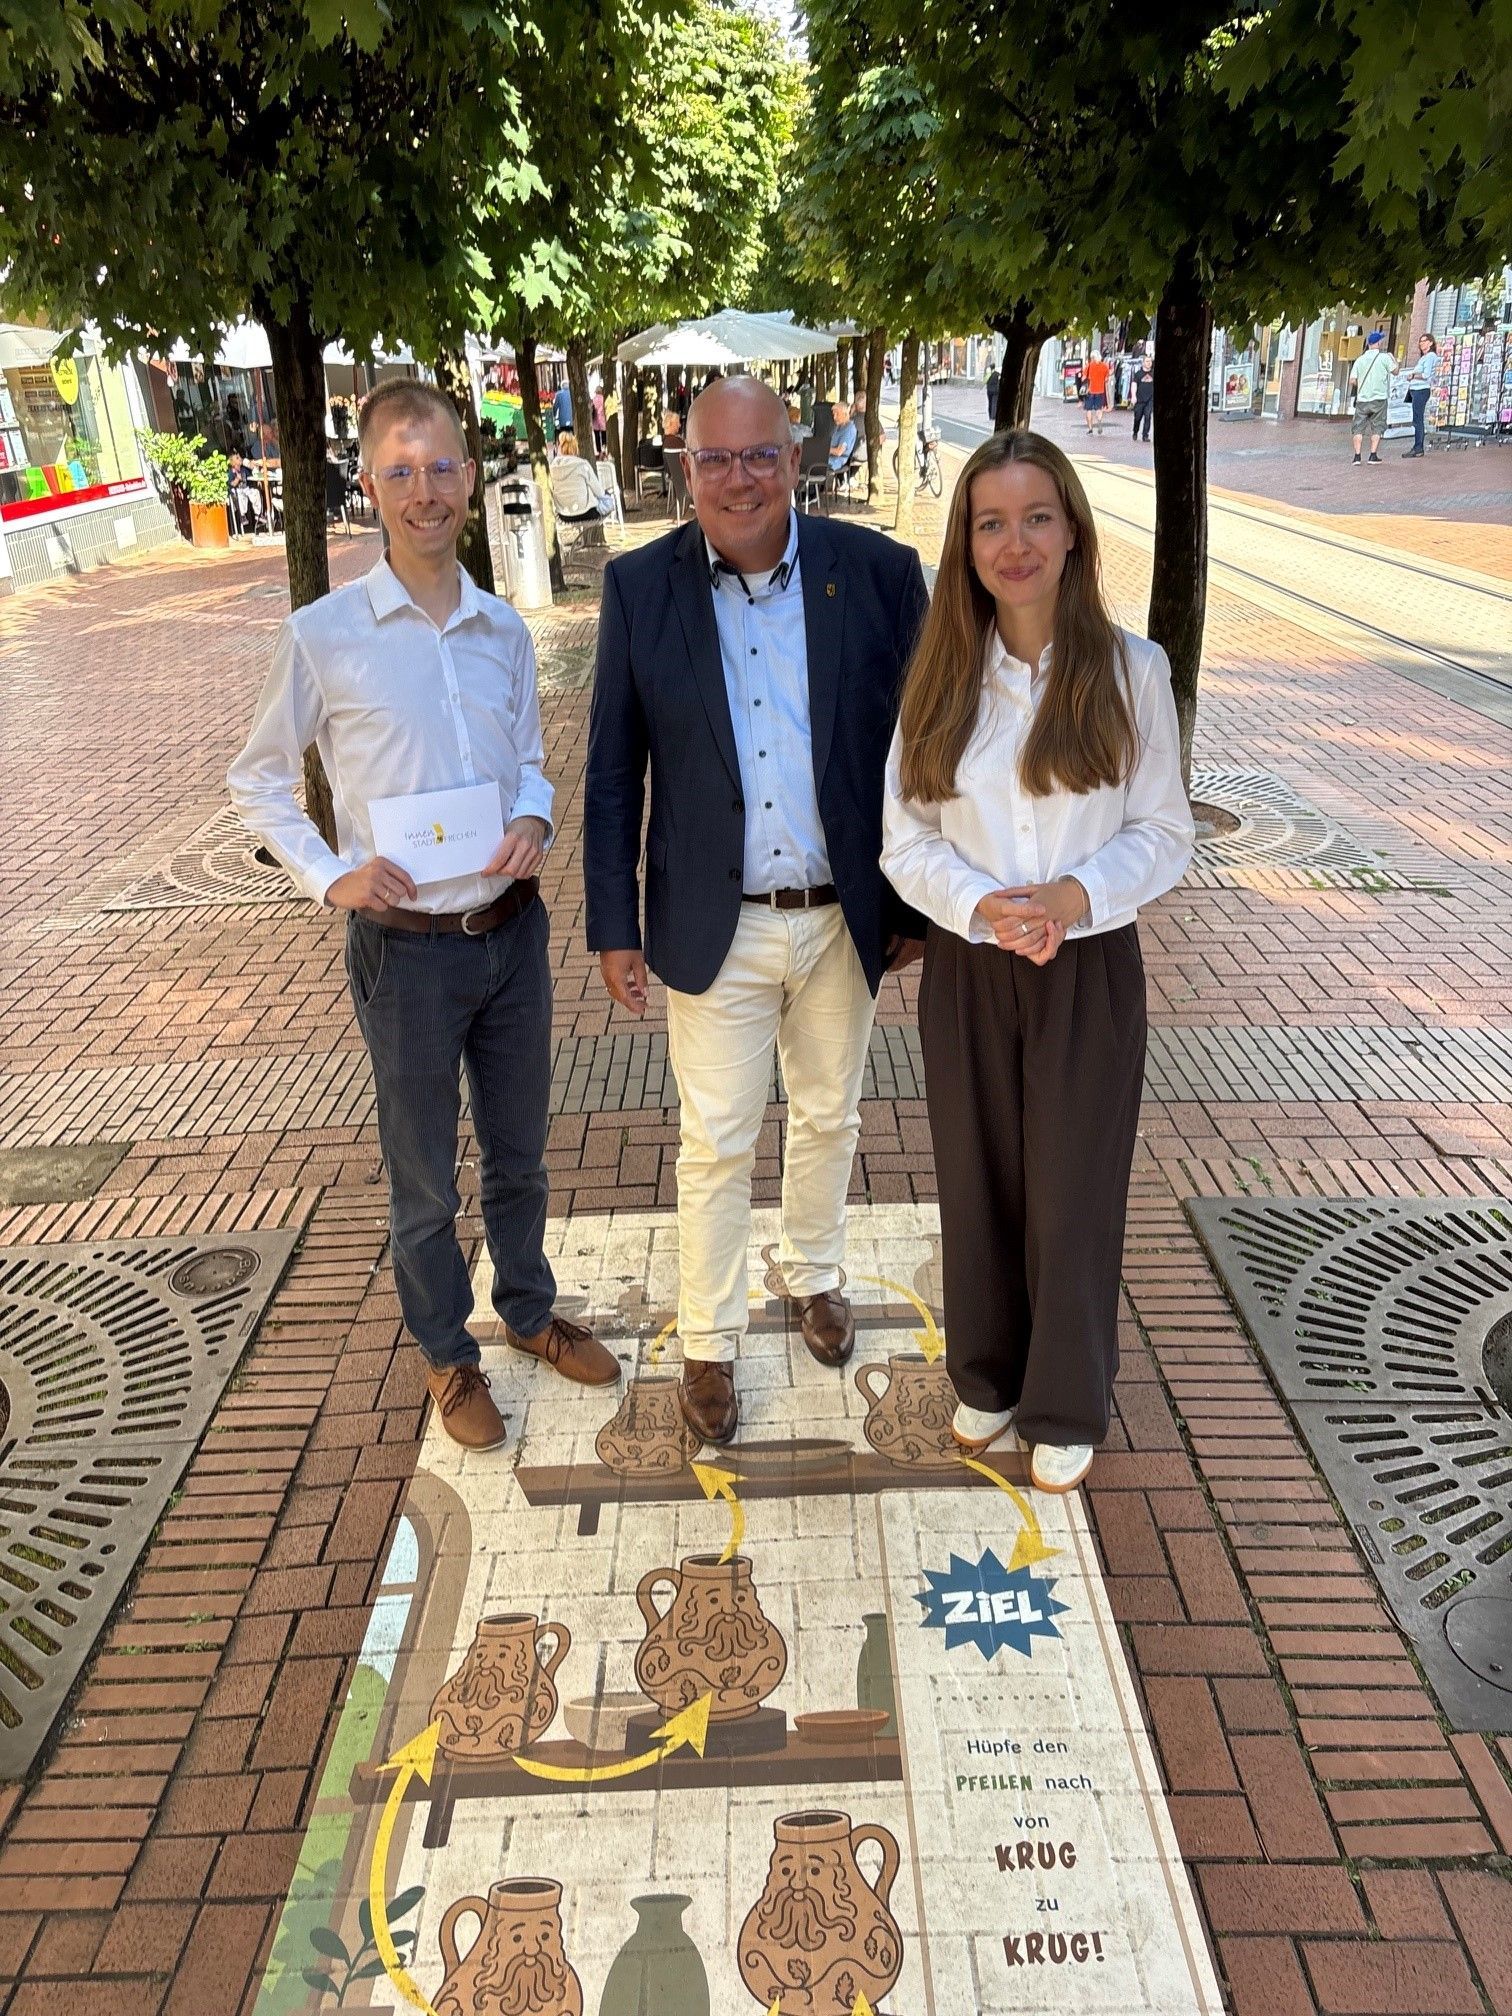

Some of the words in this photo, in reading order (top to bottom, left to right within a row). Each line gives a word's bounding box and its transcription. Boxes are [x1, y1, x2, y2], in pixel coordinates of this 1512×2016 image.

[967, 1739, 1022, 1757] Hüpfe
[1033, 1739, 1068, 1753] den
[1045, 1774, 1092, 1789] nach
[1013, 1816, 1050, 1829] von
[994, 1841, 1077, 1872] KRUG
[1035, 1898, 1059, 1911] zu
[1002, 1931, 1105, 1967] KRUG!
